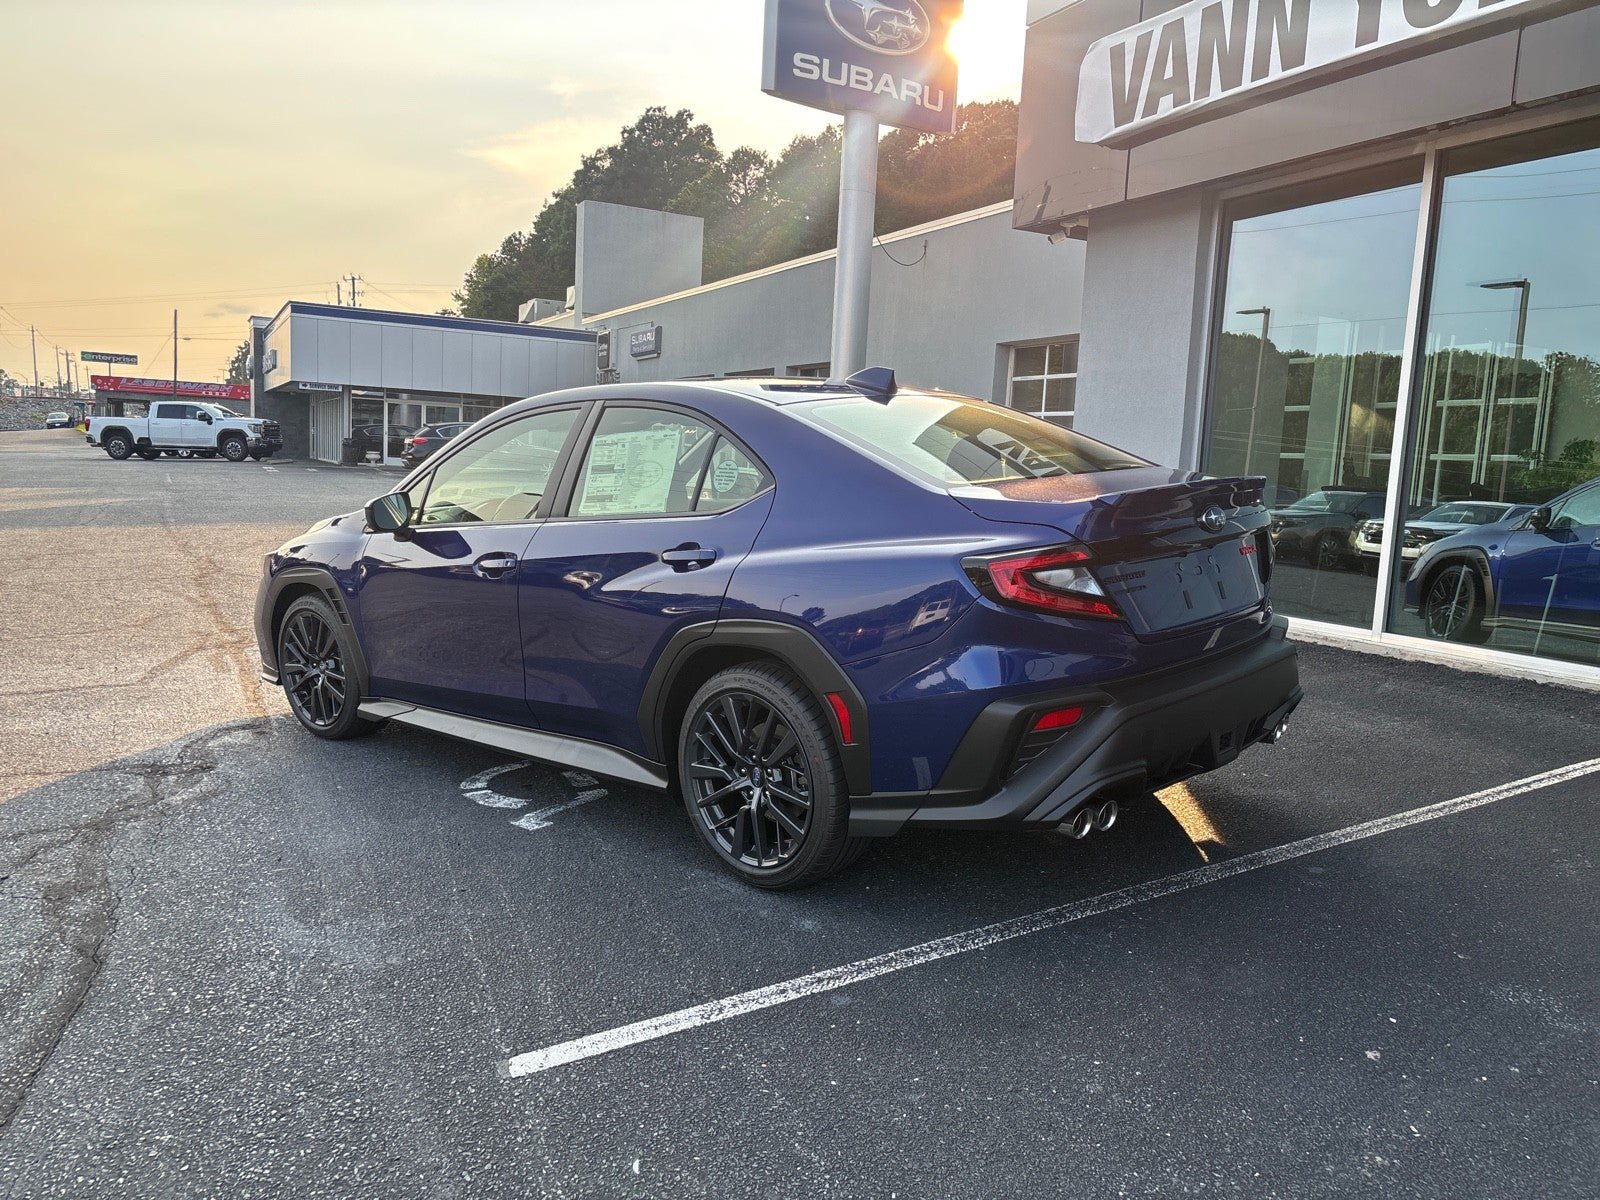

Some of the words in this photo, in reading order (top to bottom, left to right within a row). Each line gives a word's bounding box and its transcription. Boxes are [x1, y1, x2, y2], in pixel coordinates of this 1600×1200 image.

[792, 52, 944, 113] SUBARU
[1109, 0, 1311, 129] VANN
[632, 332, 655, 345] SUBARU
[83, 353, 137, 363] enterprise
